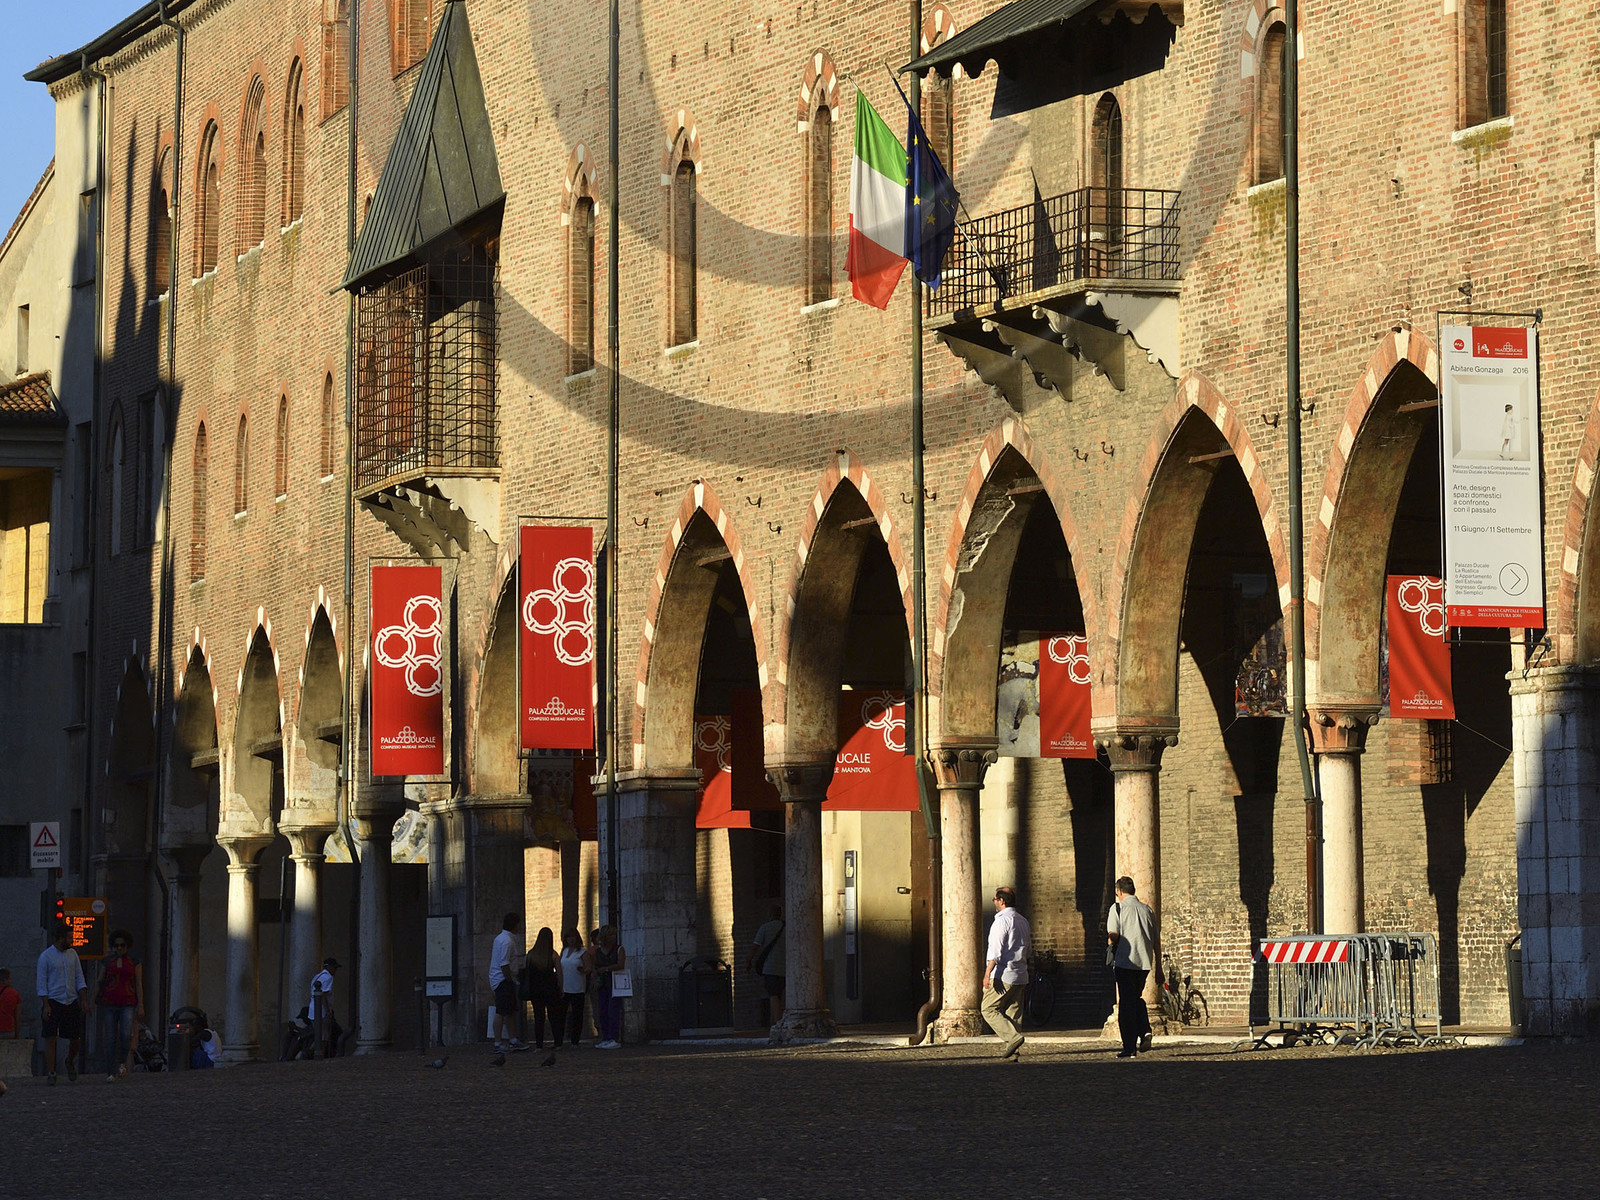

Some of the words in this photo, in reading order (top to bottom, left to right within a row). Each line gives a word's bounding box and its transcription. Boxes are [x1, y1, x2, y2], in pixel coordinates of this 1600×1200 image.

[1474, 366, 1503, 374] Gonzaga
[1453, 484, 1469, 492] Arte,
[1469, 484, 1491, 492] design
[1496, 526, 1532, 534] Settembre
